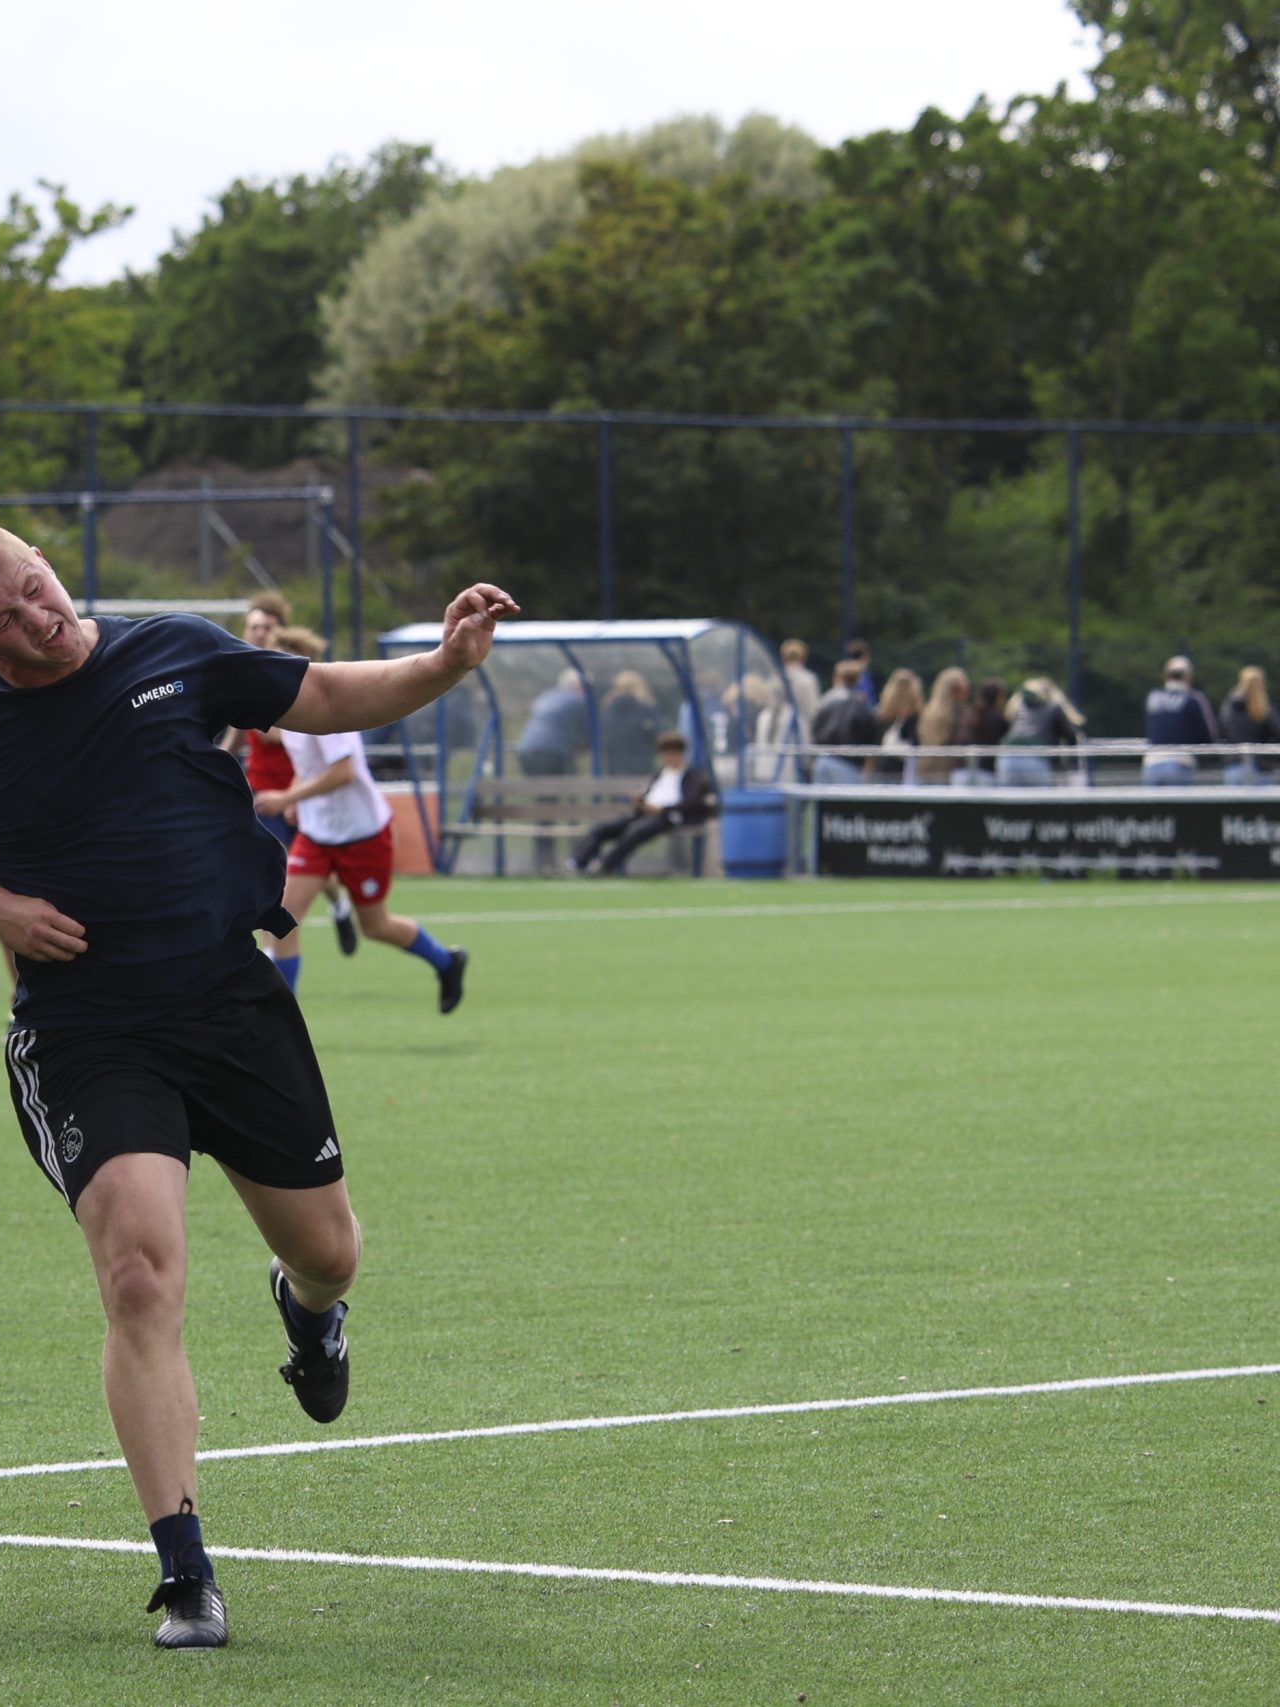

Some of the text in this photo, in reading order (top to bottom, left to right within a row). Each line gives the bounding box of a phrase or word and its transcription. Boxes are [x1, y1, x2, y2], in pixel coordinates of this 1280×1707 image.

[984, 816, 1176, 848] Voor uw veiligheid
